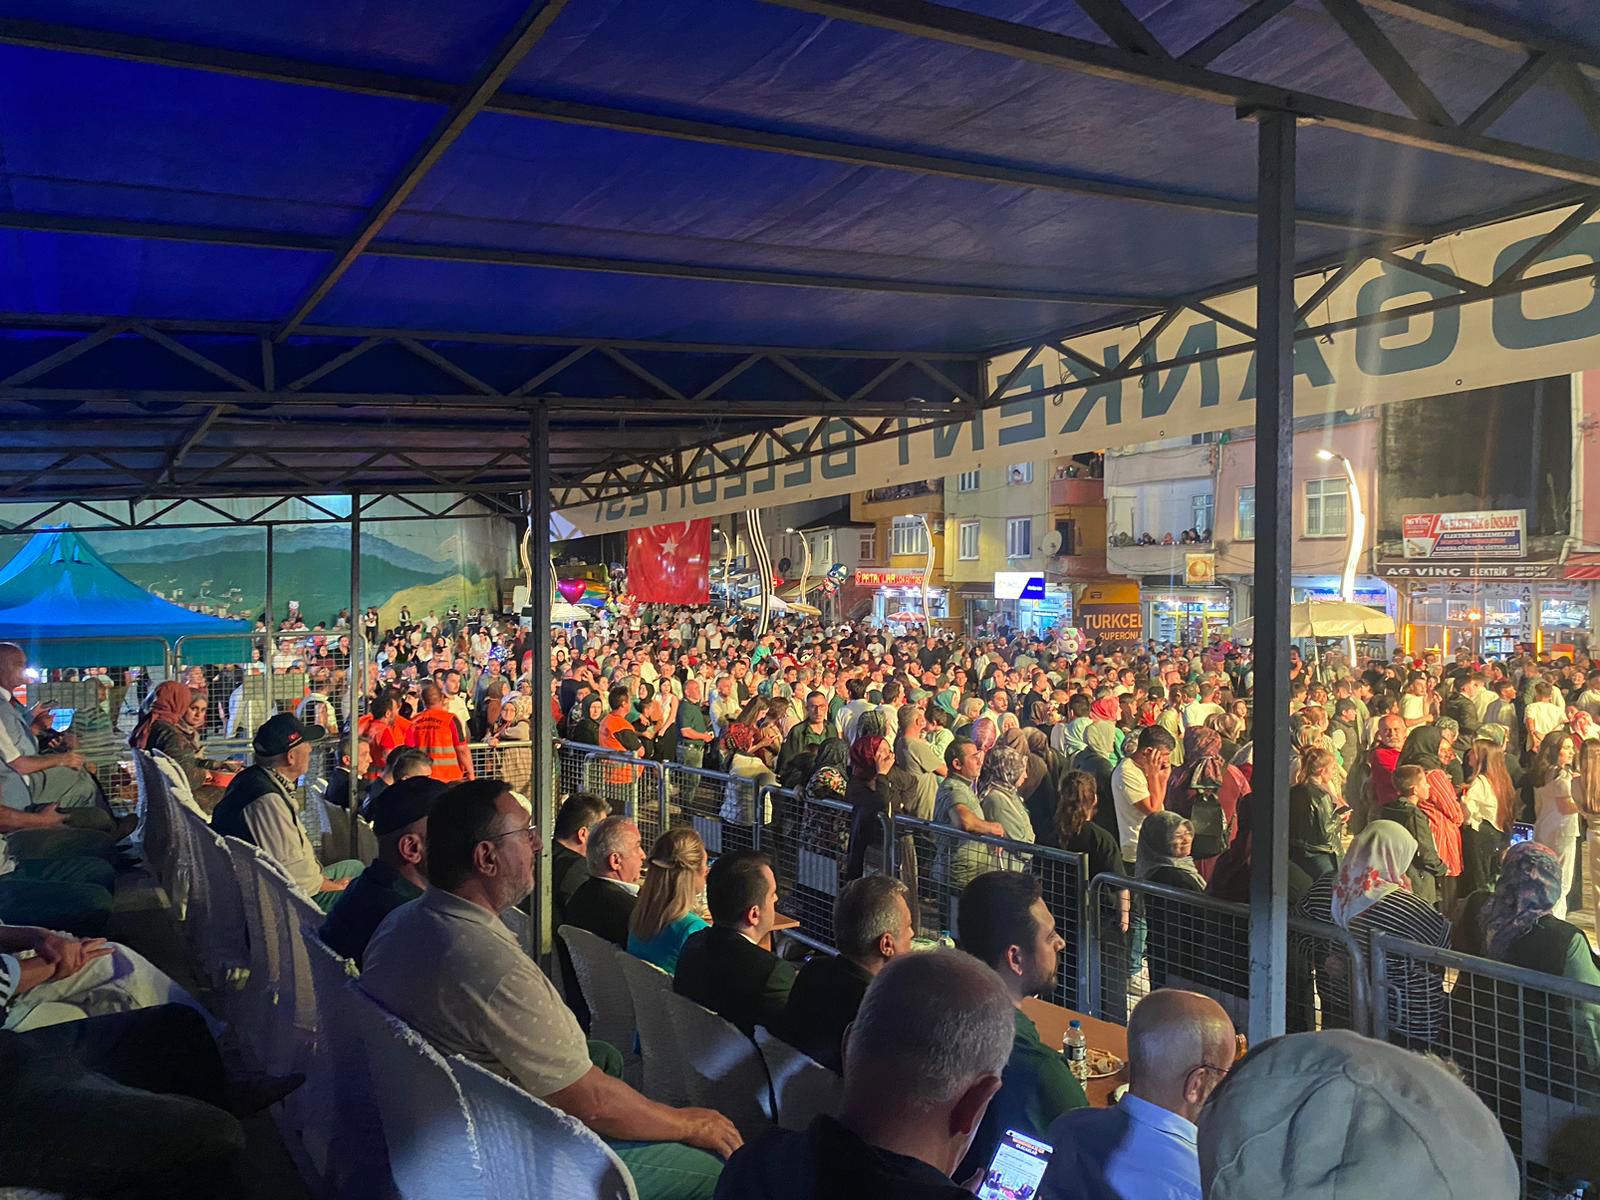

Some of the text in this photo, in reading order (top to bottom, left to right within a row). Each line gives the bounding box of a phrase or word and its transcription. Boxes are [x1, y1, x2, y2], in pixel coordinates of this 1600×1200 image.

[1386, 567, 1411, 576] AG
[1415, 566, 1462, 577] VİNÇ
[1469, 567, 1509, 577] ELEKTRİK
